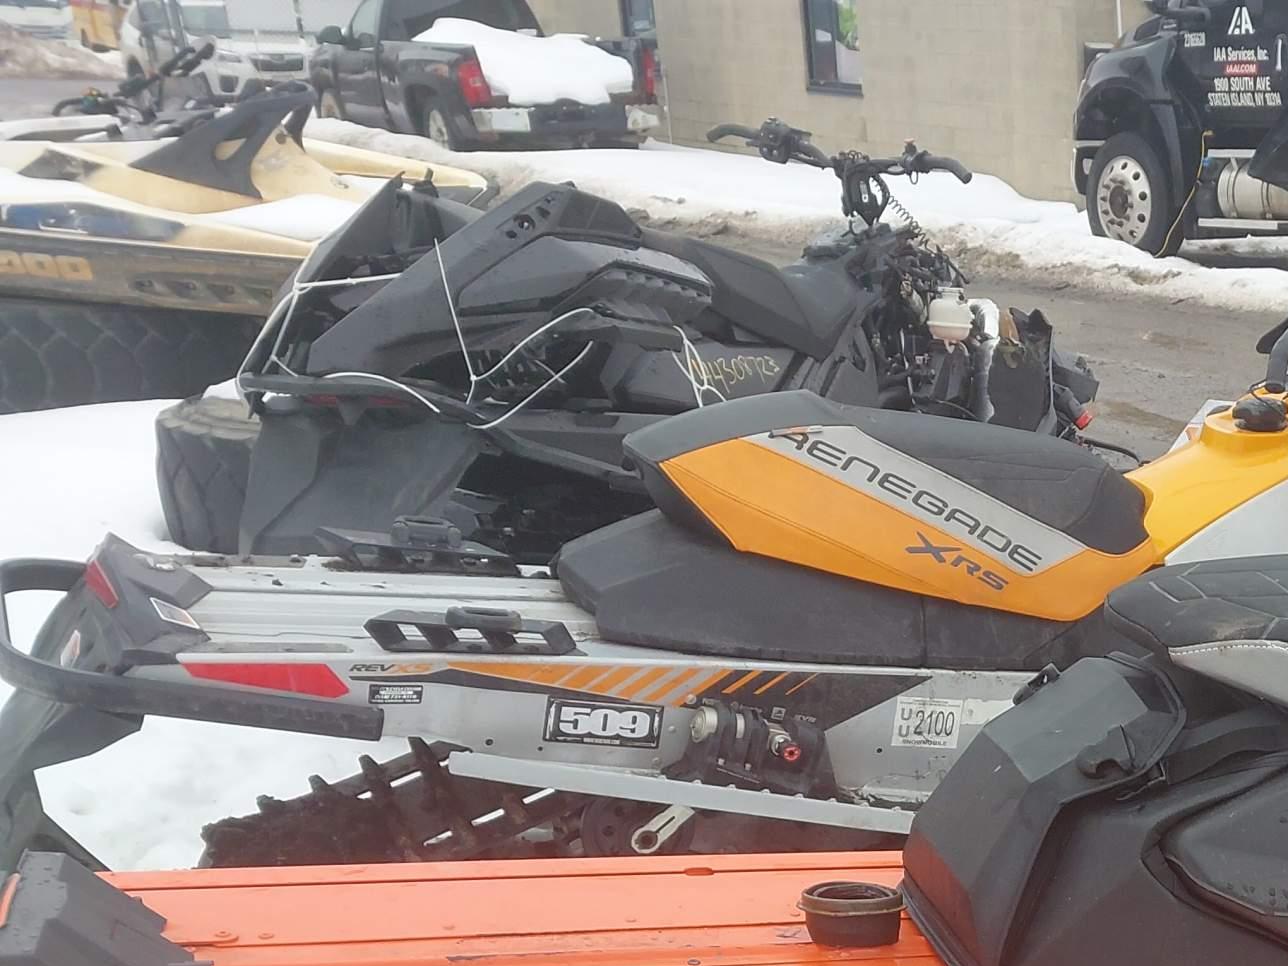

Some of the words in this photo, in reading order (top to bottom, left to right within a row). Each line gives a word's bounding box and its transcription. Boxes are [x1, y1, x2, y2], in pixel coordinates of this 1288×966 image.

[1213, 47, 1226, 61] IAA
[1227, 46, 1256, 62] Services,
[1257, 45, 1269, 60] Inc.
[1213, 77, 1229, 91] 1900
[1230, 77, 1254, 91] SOUTH
[1256, 76, 1271, 91] AVE
[1208, 92, 1230, 106] STATEN
[1255, 92, 1265, 106] NY
[782, 430, 1042, 573] RENEGADE
[905, 531, 1009, 591] XRS
[559, 706, 651, 738] 509
[914, 710, 955, 736] 2100
